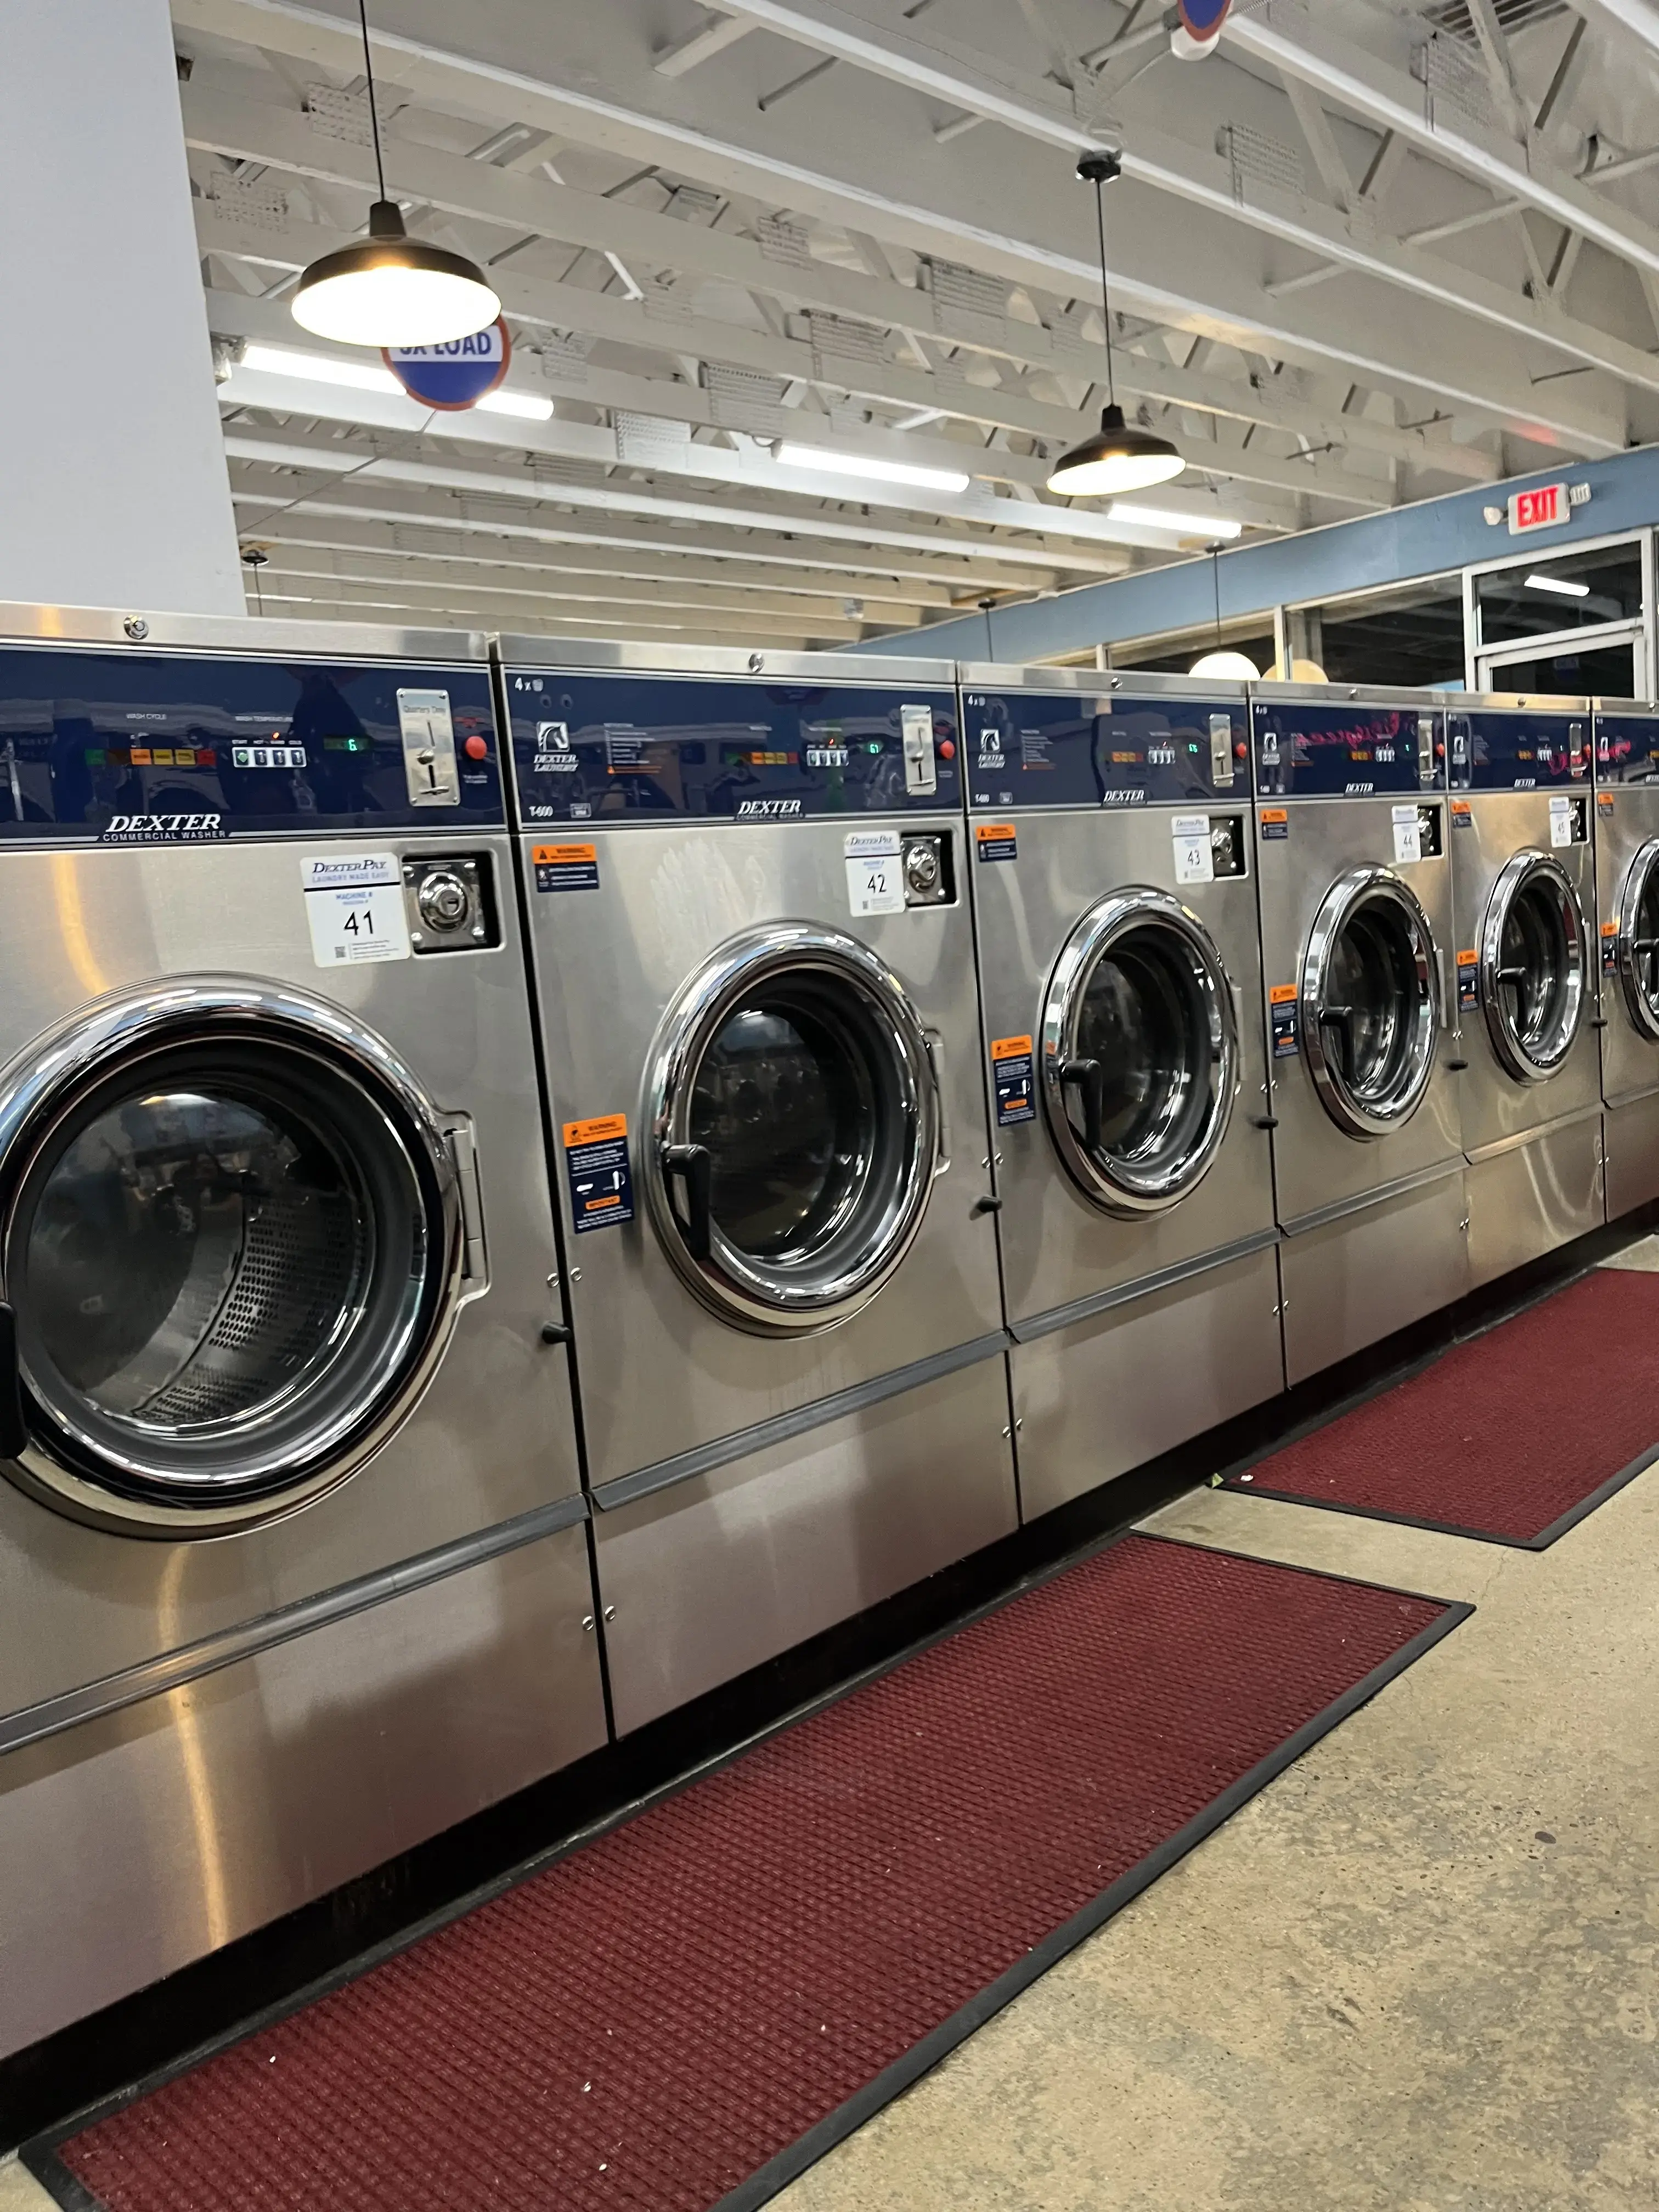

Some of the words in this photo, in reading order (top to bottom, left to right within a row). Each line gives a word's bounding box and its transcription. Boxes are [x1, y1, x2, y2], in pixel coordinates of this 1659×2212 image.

[1517, 486, 1559, 528] EXIT
[1103, 789, 1144, 802] DEXTER
[737, 800, 802, 814] DEXTER
[105, 814, 221, 832] DEXTER
[103, 832, 178, 842] COMMERCIAL
[181, 831, 226, 839] WASHER
[1403, 833, 1413, 848] 44
[1188, 849, 1200, 865] 43
[312, 874, 348, 883] LAUNDRY
[867, 874, 887, 894] 42
[343, 910, 374, 936] 41
